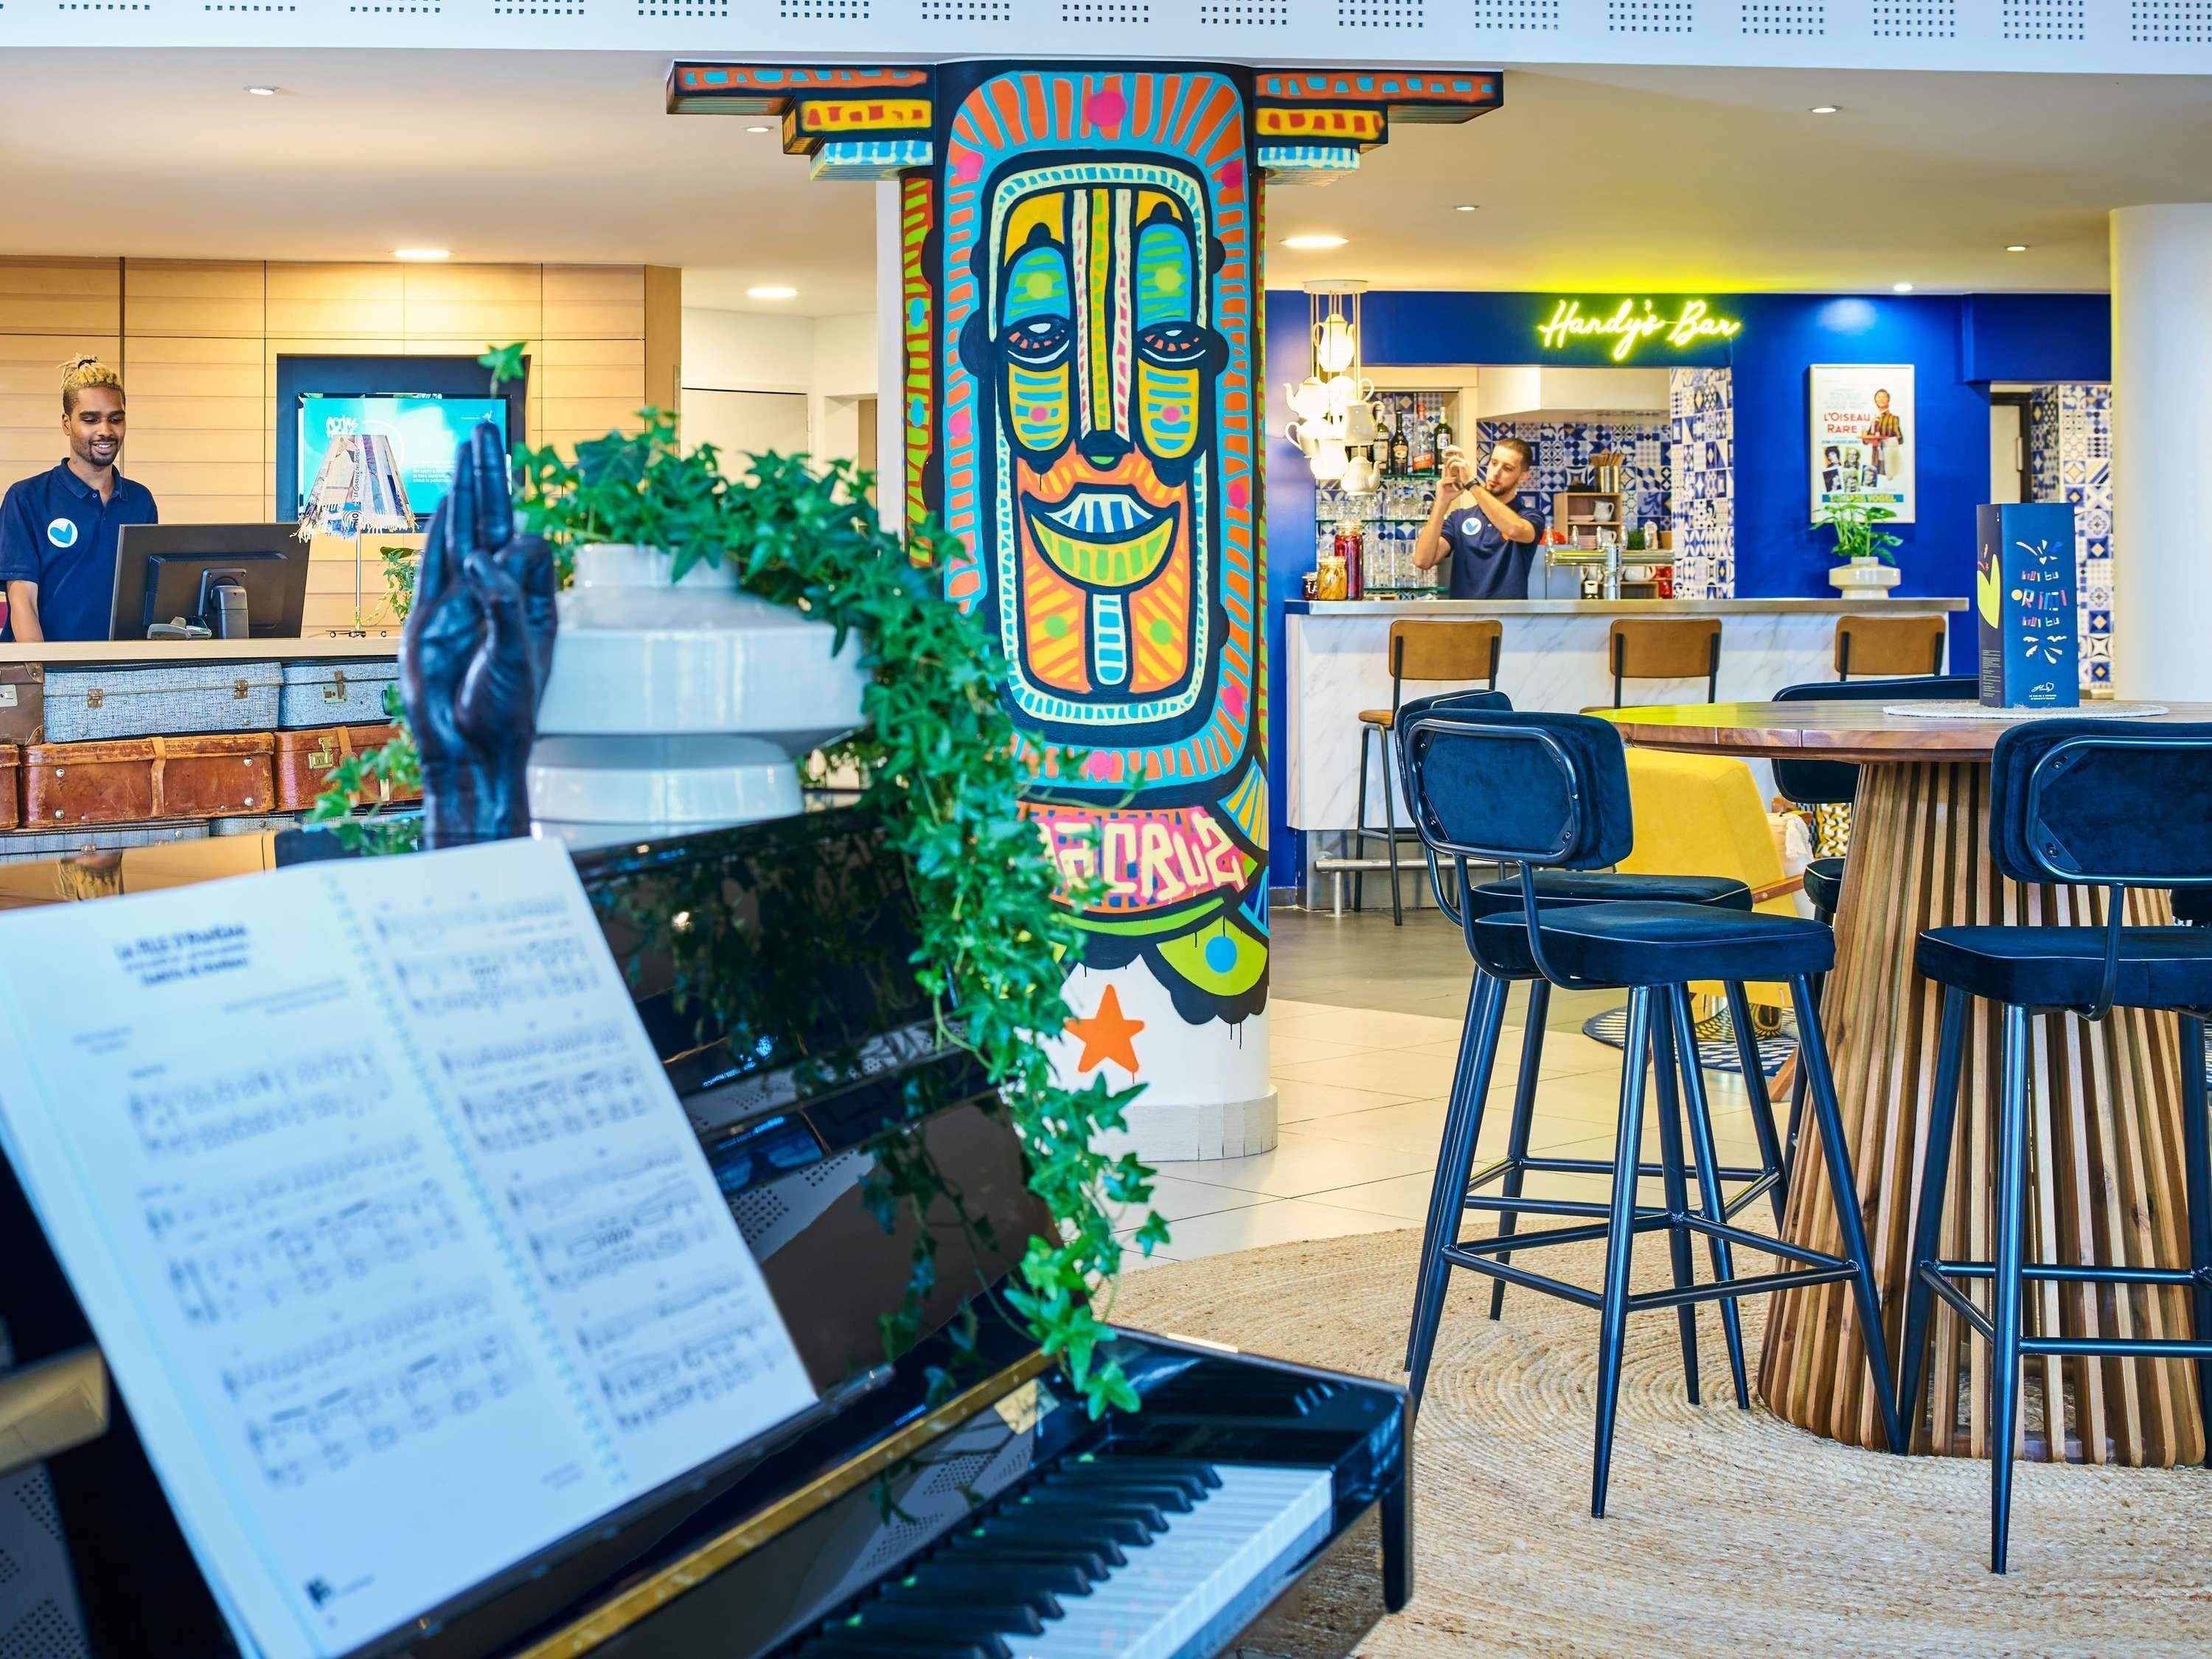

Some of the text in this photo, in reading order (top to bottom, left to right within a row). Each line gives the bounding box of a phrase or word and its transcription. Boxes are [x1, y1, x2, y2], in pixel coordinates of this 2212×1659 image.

[1537, 298, 1741, 361] Handy's Bar
[1823, 411, 1871, 422] L'OISEAU
[1827, 423, 1858, 434] RARE
